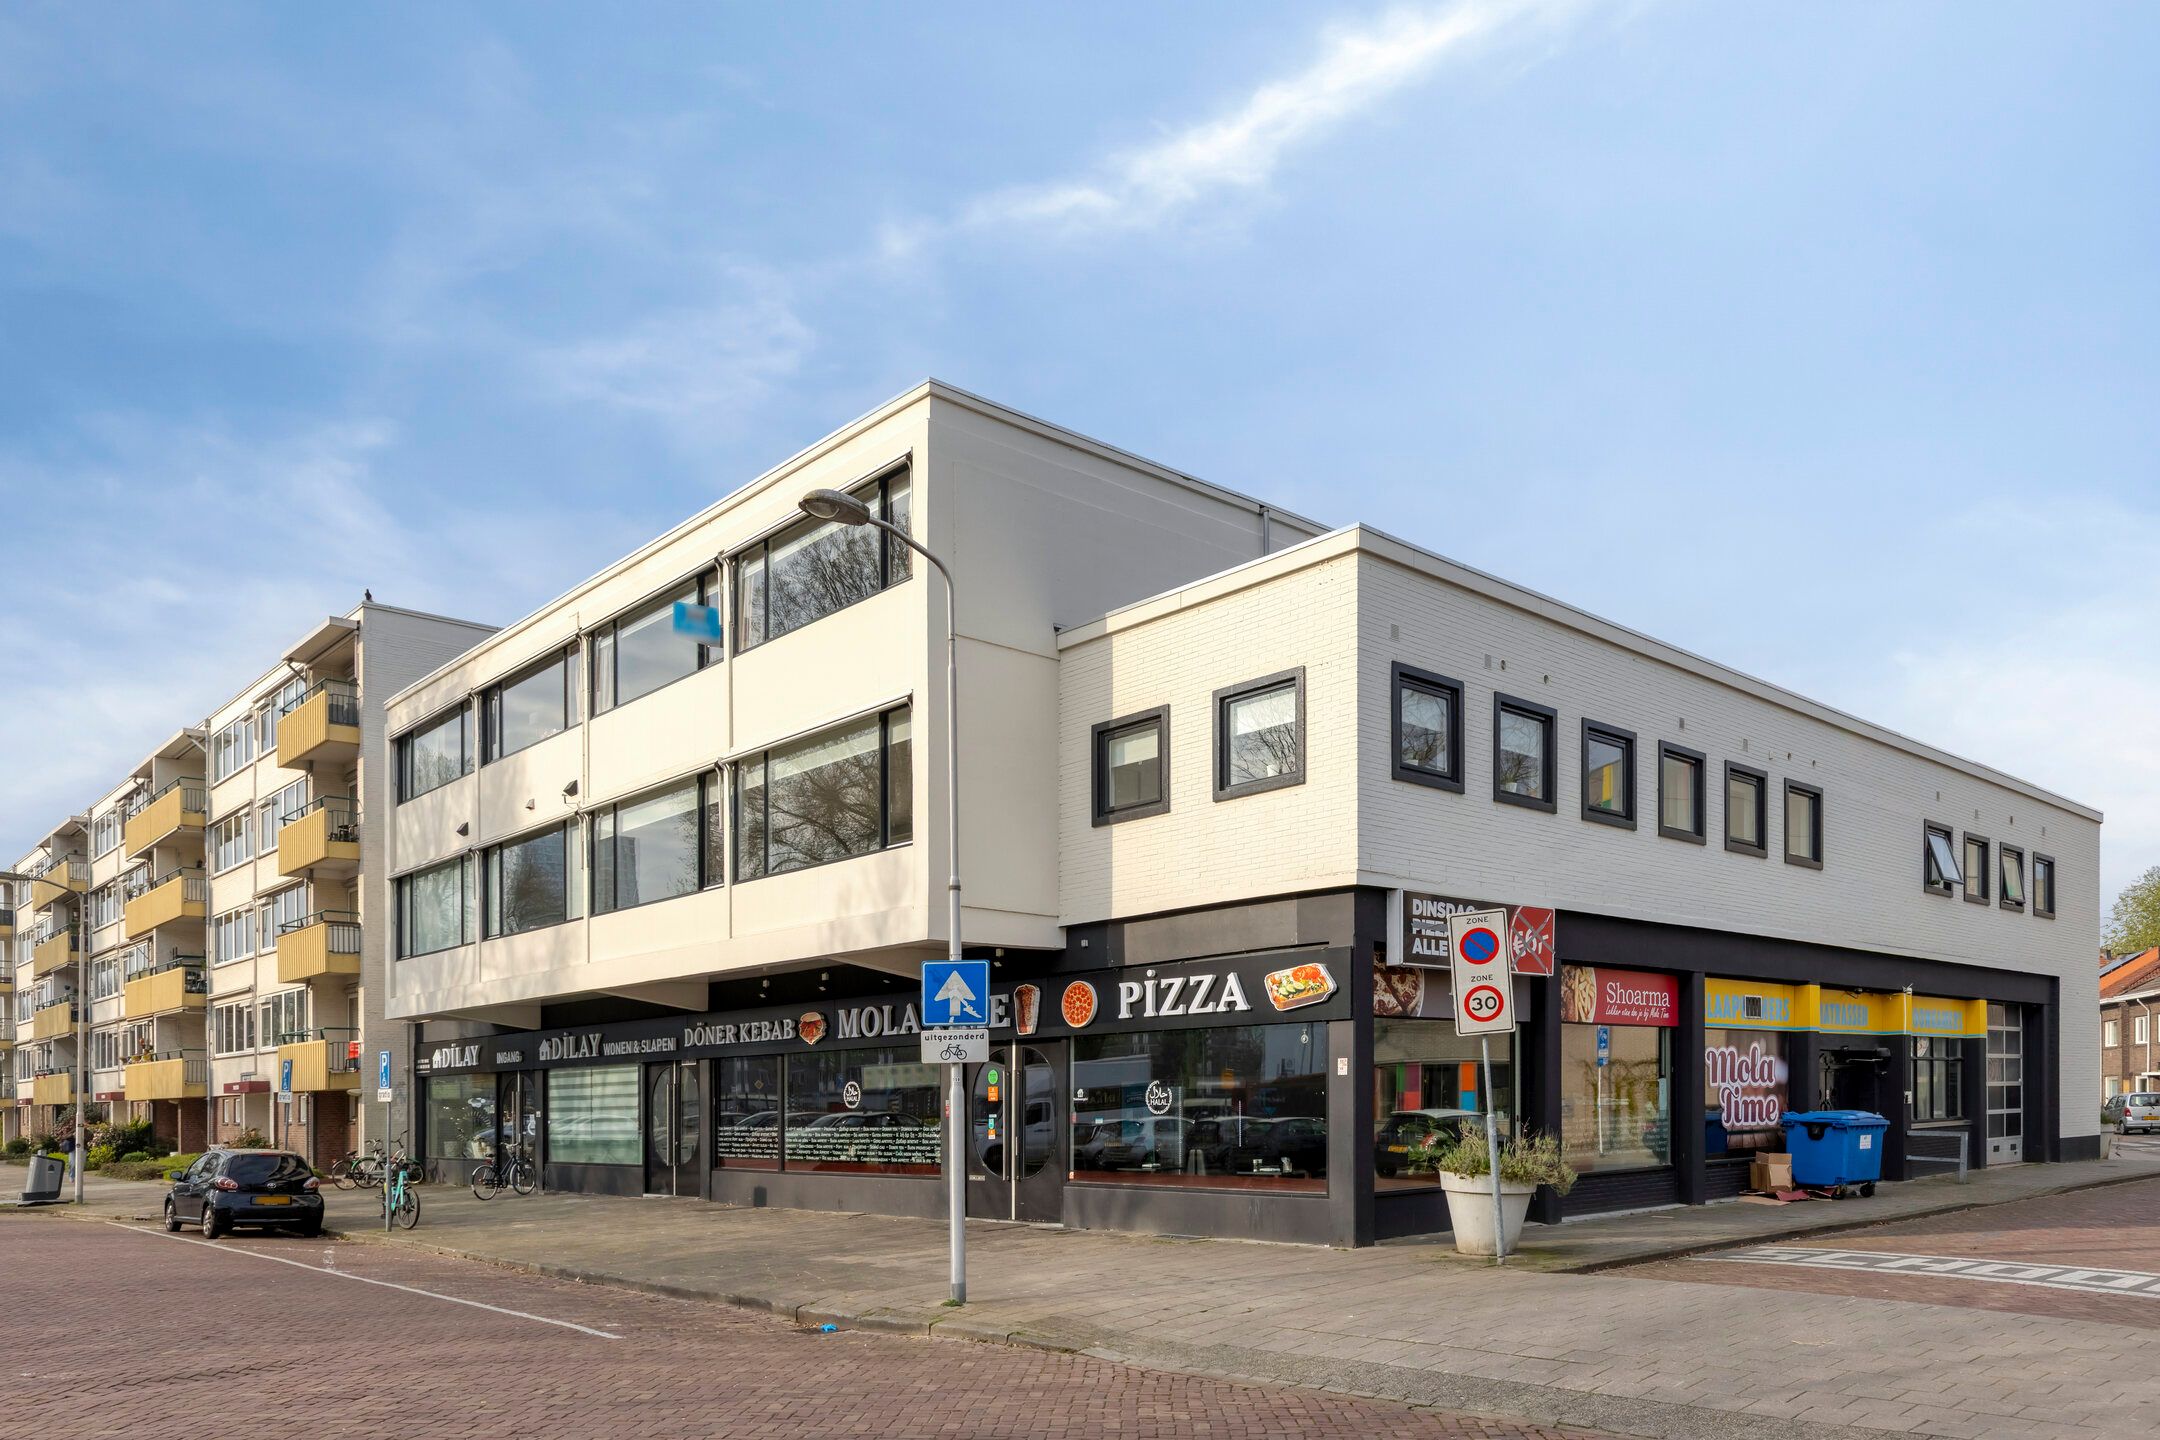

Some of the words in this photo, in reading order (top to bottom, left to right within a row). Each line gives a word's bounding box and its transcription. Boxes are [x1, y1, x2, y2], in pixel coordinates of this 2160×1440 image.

[1466, 916, 1489, 925] ZONE
[1412, 938, 1448, 957] ALLE
[1470, 974, 1494, 983] ZONE
[1471, 996, 1498, 1011] 30
[1606, 982, 1671, 1007] Shoarma
[837, 1002, 922, 1039] MOLA
[684, 1022, 737, 1047] DÖNER
[739, 1019, 796, 1042] KEBAB
[924, 1032, 985, 1042] uitgezonderd
[603, 1041, 633, 1056] WONEN
[633, 1040, 640, 1054] &
[640, 1038, 676, 1053] SLAPEN
[496, 1051, 520, 1064] INGANG
[1706, 1043, 1775, 1085] Mola
[1150, 1098, 1167, 1106] HALAL
[1720, 1085, 1778, 1125] Time
